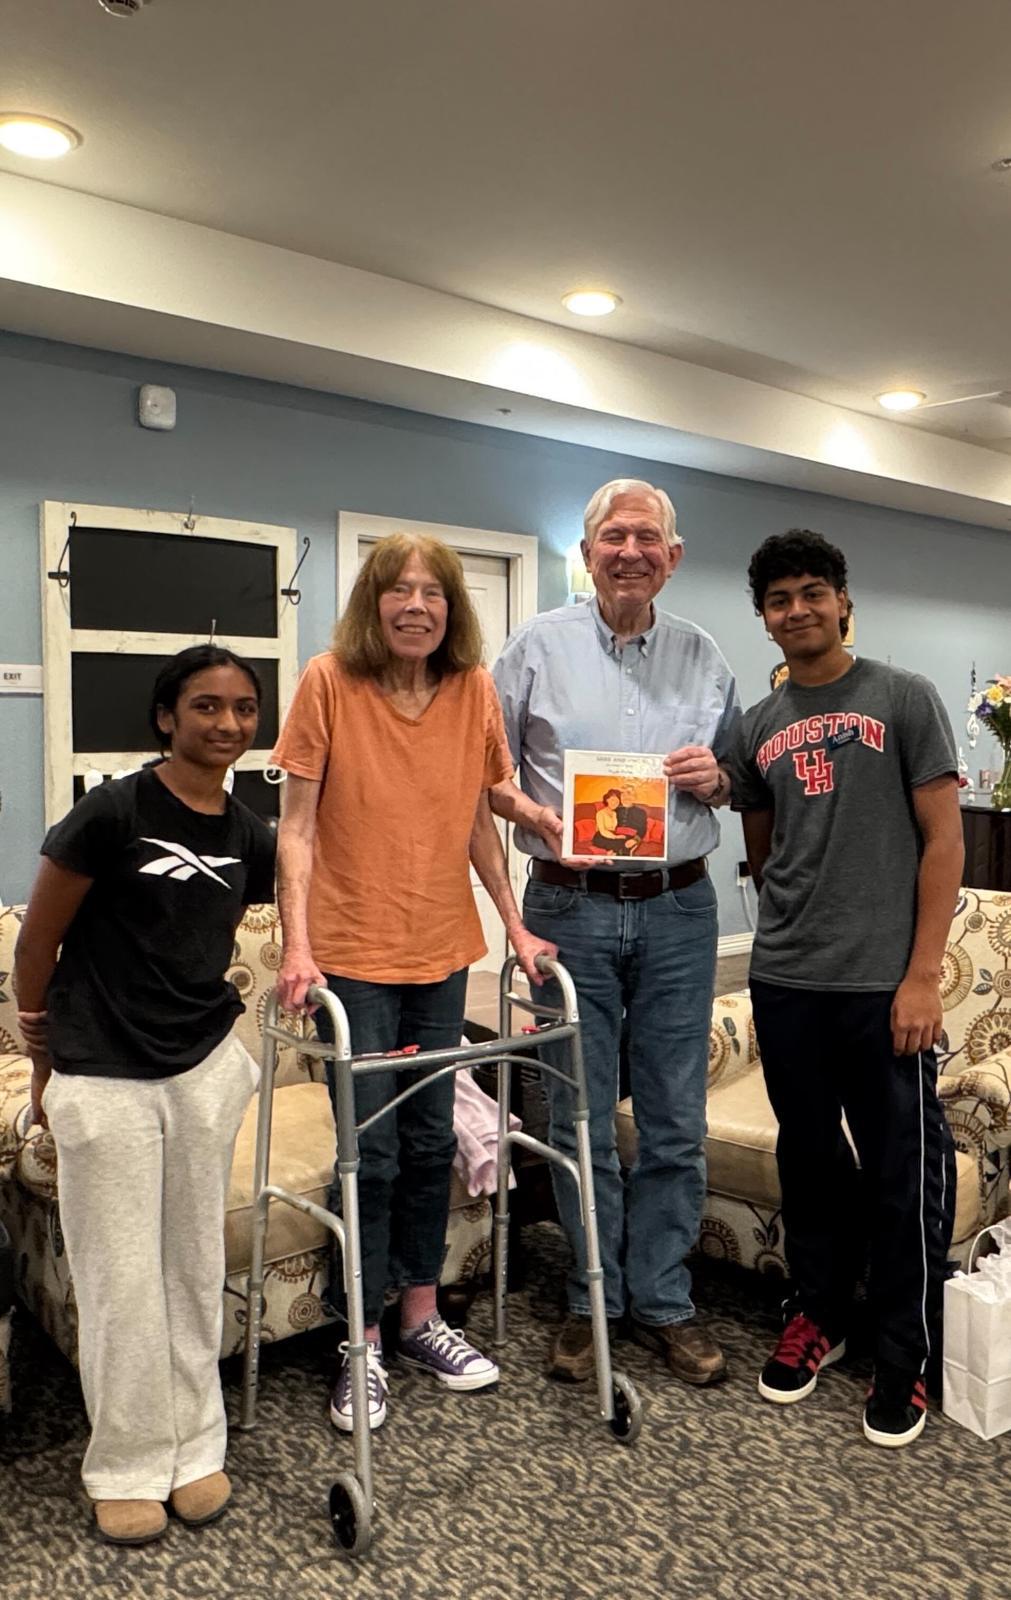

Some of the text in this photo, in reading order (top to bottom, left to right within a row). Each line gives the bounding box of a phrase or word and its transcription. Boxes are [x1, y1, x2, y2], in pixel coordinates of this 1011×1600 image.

[3, 672, 22, 681] EXIT
[757, 712, 885, 778] HOUSTON
[793, 749, 834, 795] UH
